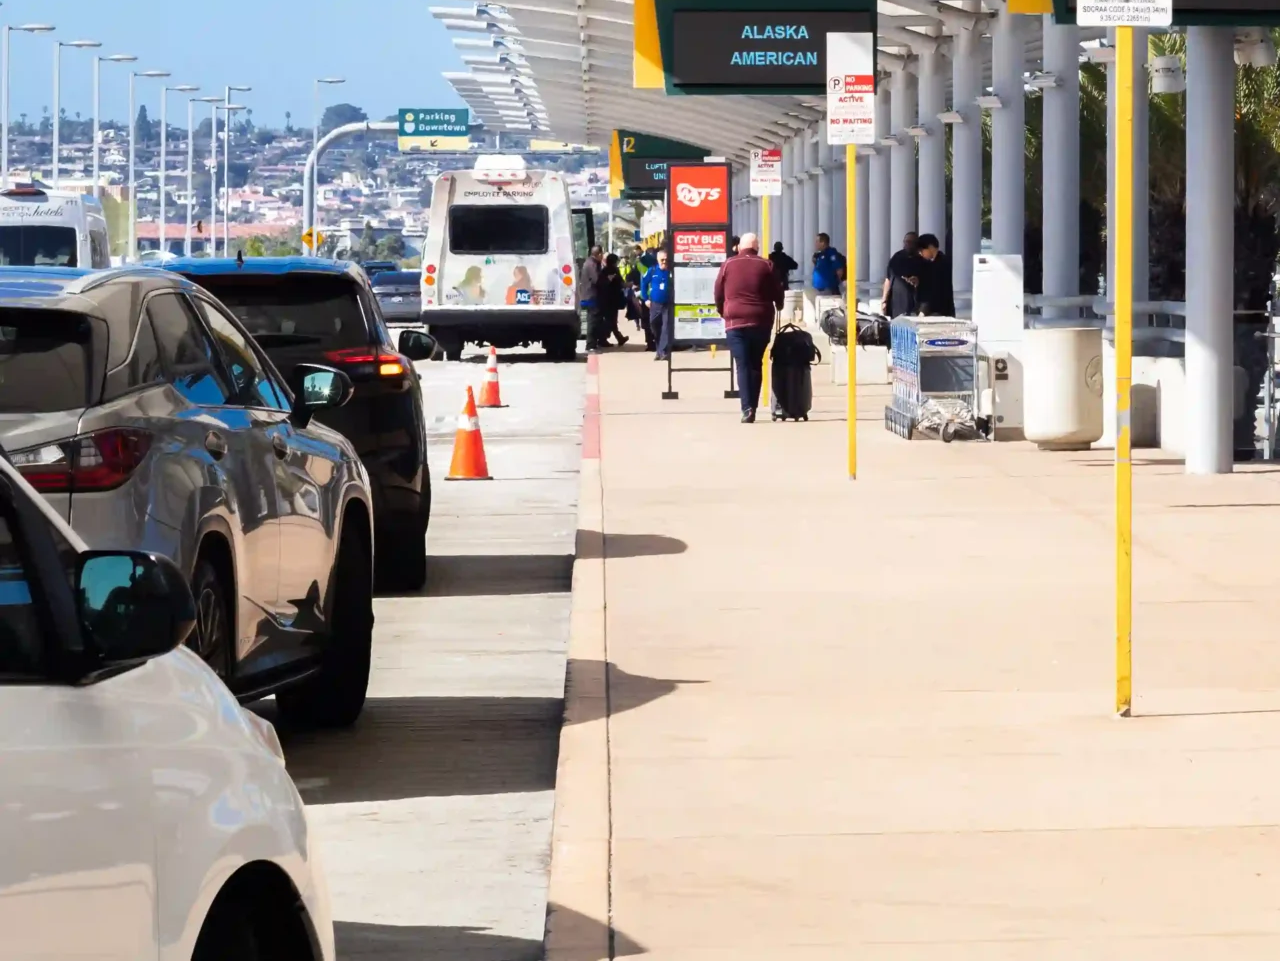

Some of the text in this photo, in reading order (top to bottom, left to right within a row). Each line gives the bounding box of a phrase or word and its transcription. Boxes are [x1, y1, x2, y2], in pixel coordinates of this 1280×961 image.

[741, 25, 809, 39] ALASKA
[730, 52, 817, 65] AMERICAN
[419, 112, 456, 123] Parking
[625, 137, 635, 152] 2
[676, 183, 721, 207] MTS
[32, 205, 64, 217] hotels
[677, 235, 723, 244] CITY BUS
